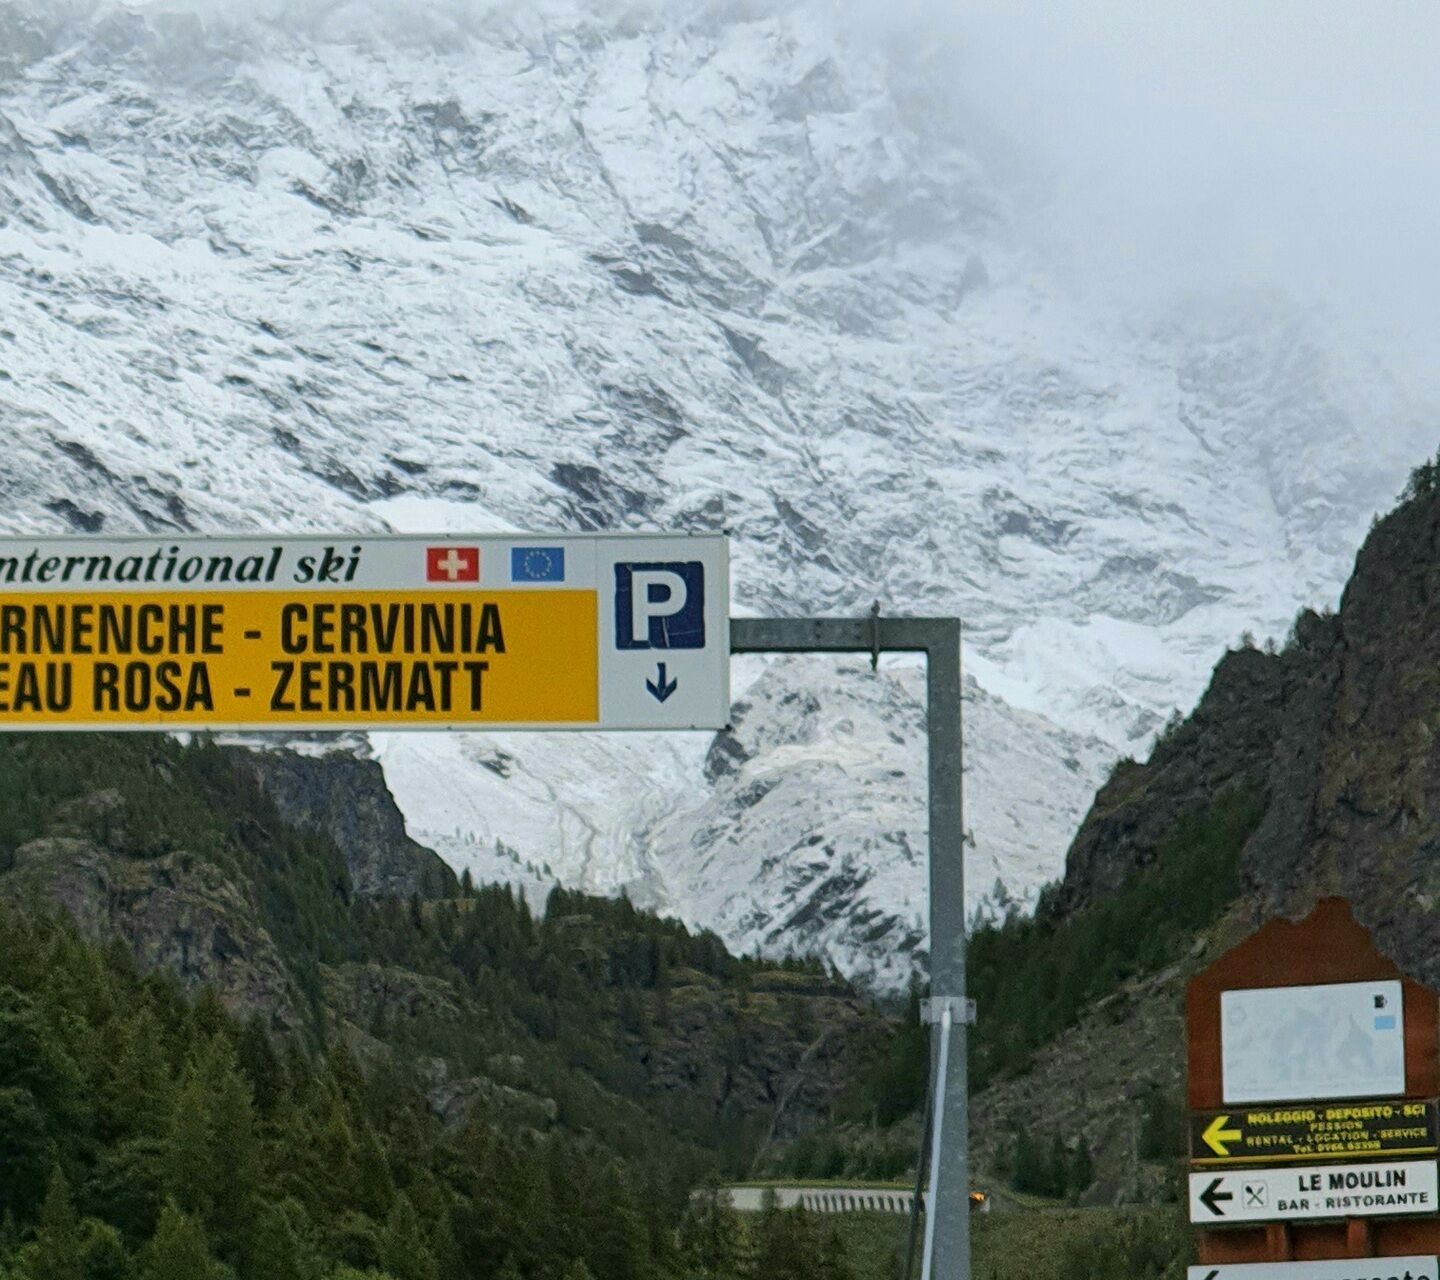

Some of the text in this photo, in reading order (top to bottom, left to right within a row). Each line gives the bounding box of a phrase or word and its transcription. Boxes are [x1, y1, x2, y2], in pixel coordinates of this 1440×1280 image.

[293, 545, 362, 583] ski
[632, 571, 687, 641] P
[281, 602, 506, 654] CERVINIA
[93, 660, 214, 712] ROSA
[270, 660, 489, 712] ZERMATT
[1247, 1109, 1315, 1125] NOLEGGIO
[1326, 1105, 1393, 1121] DEPOSITO
[1403, 1104, 1426, 1118] SCI
[1246, 1135, 1293, 1147] RENTAL
[1307, 1130, 1369, 1144] LOCATION
[1380, 1127, 1427, 1139] SERVICE
[1298, 1169, 1406, 1192] LE MOULIN
[1277, 1198, 1310, 1211] BAR
[1326, 1191, 1429, 1209] RISTORANTE
